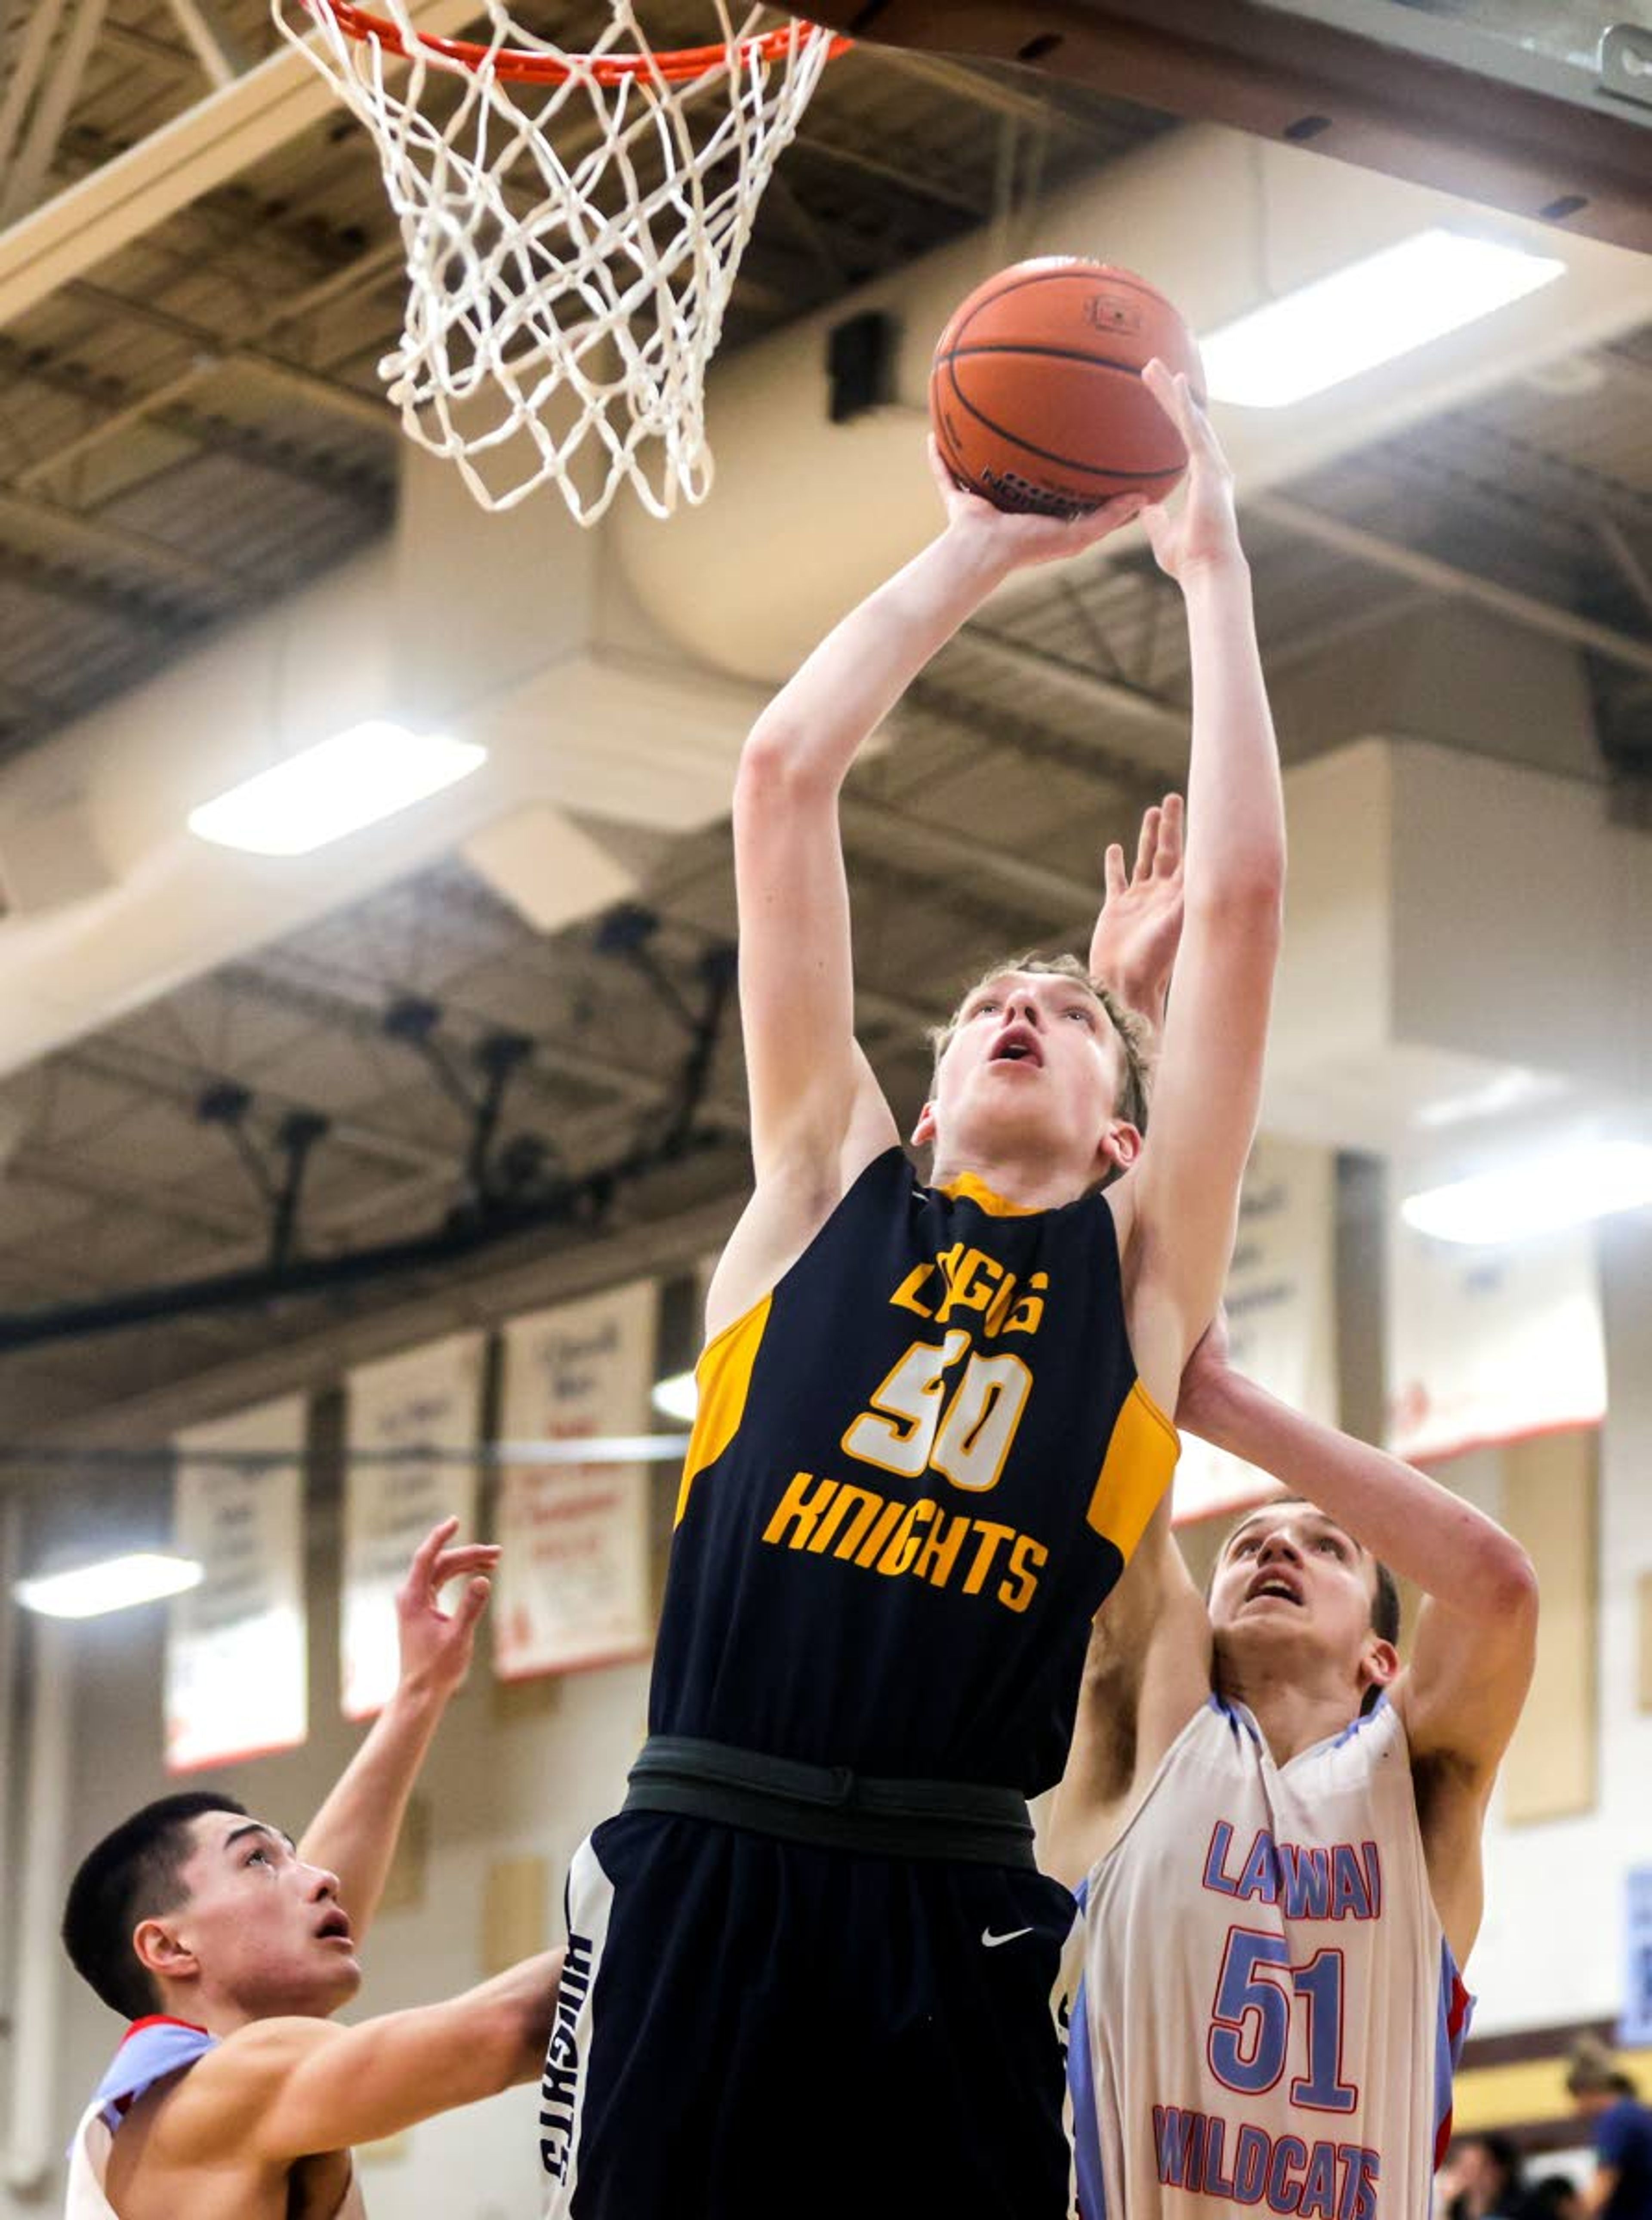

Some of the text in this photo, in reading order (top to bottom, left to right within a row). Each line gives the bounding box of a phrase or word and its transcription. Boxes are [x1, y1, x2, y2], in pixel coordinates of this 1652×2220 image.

[841, 1329, 1033, 1492] 50
[761, 1471, 1049, 1613] KNIGHTS
[1207, 1924, 1358, 2114] 51
